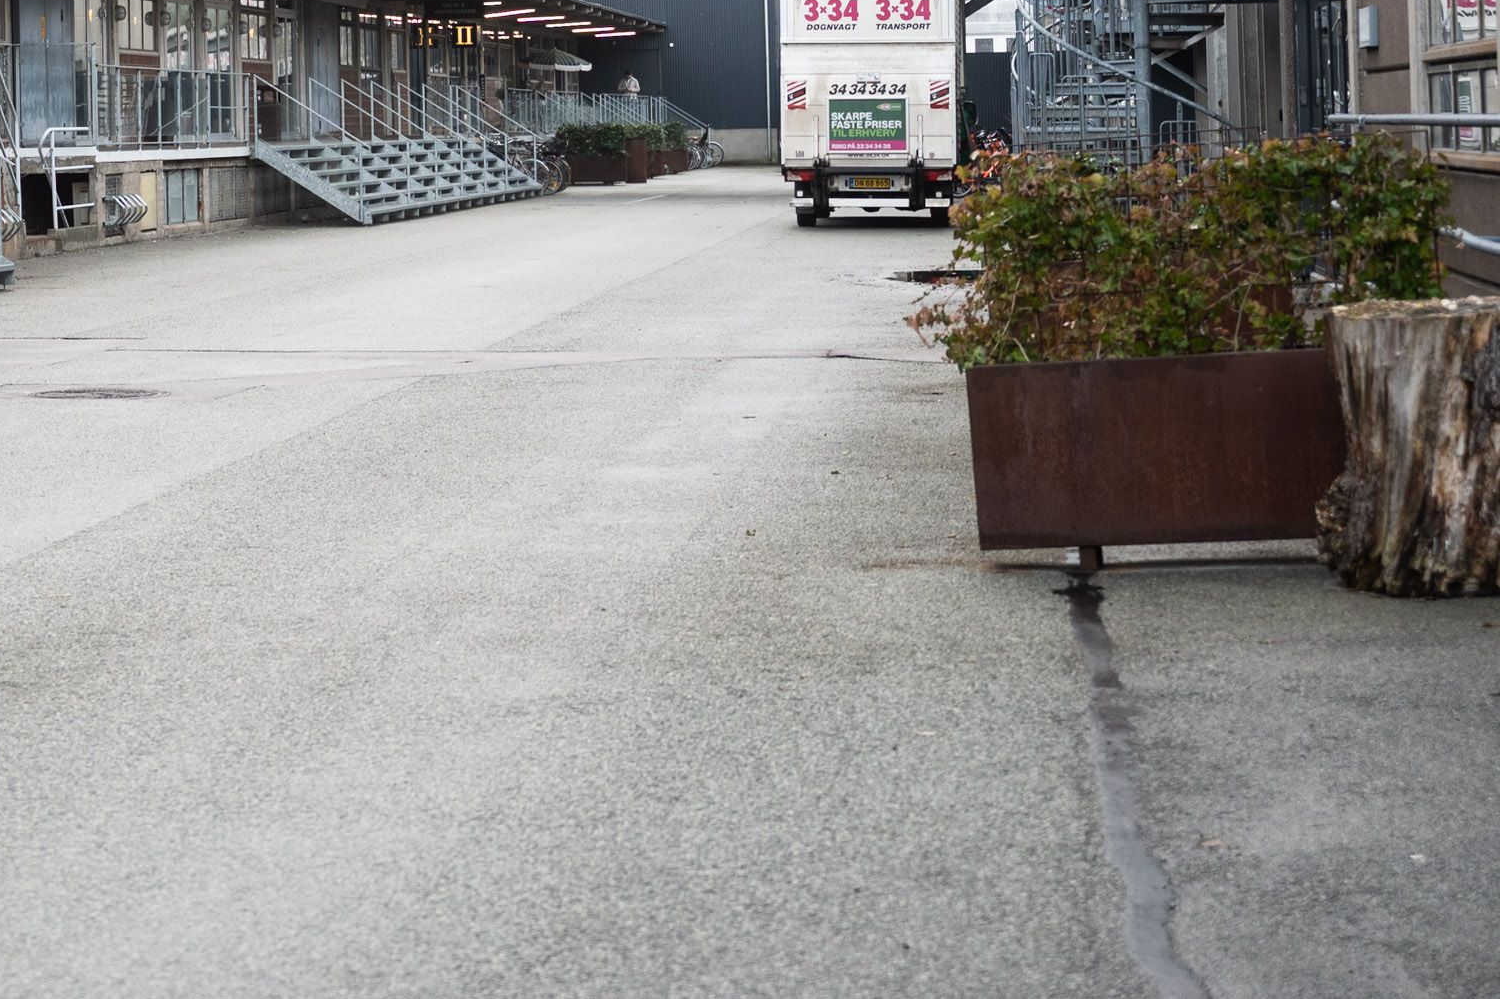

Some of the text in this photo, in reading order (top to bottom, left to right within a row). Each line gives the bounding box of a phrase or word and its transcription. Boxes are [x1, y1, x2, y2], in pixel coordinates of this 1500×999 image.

[829, 84, 847, 95] 34
[889, 84, 907, 95] 34
[831, 112, 872, 121] SKARPE
[831, 120, 902, 129] FASTE PRISER
[832, 129, 896, 137] TIL ERHVERV
